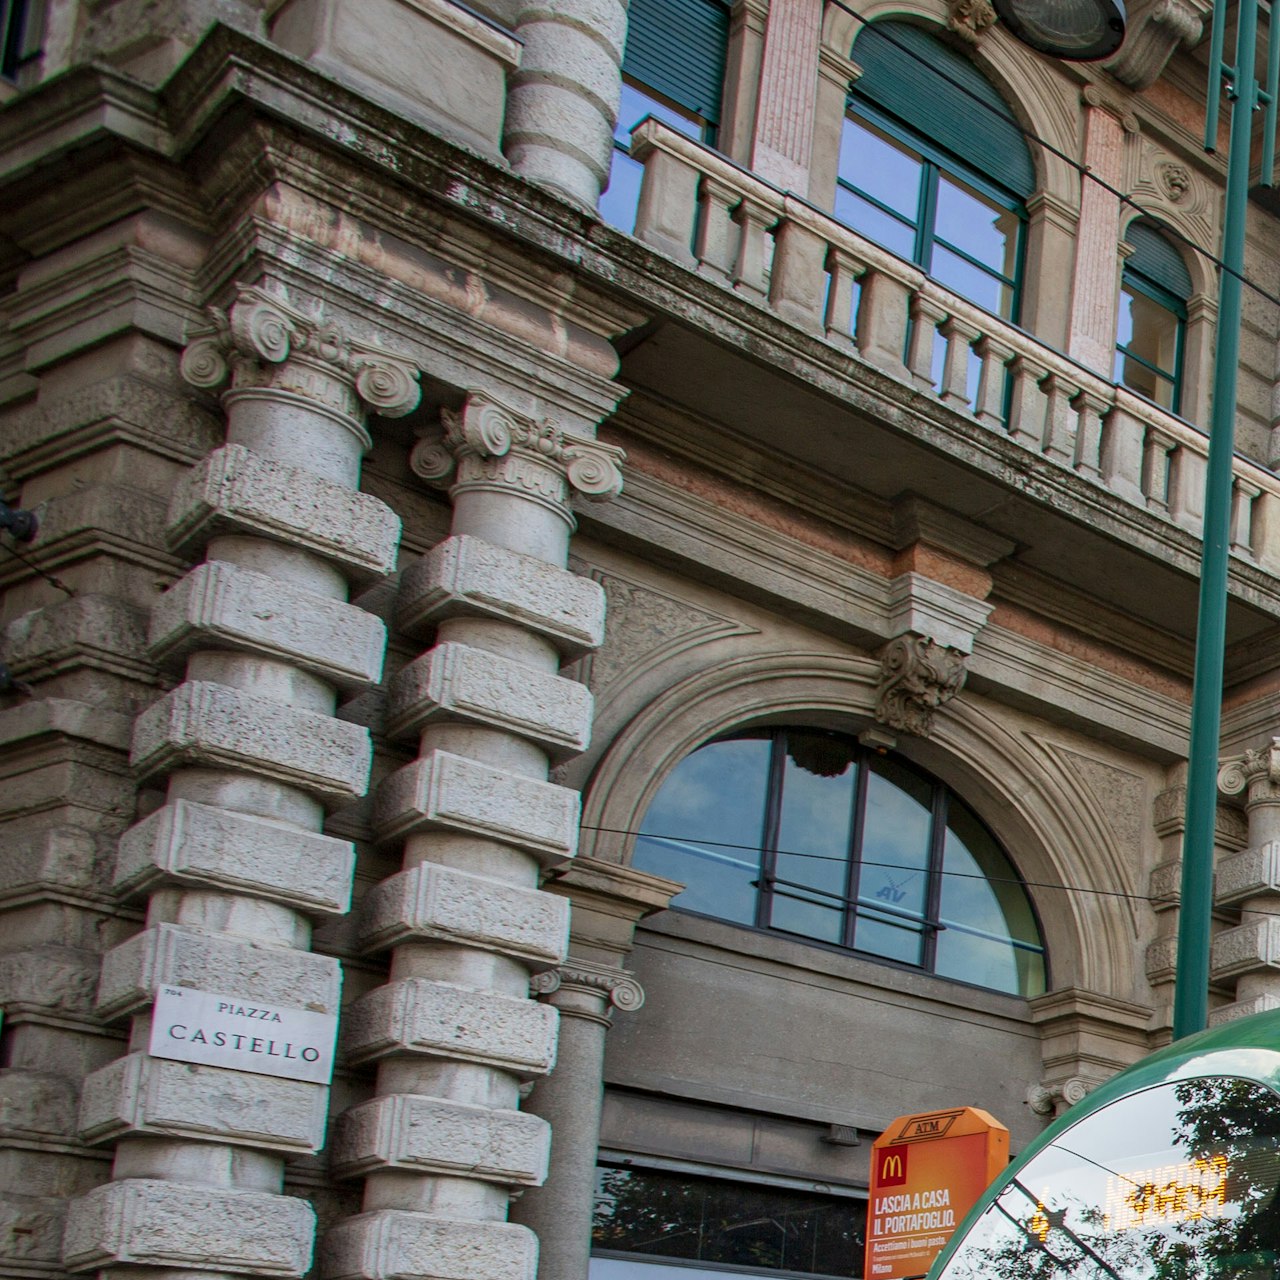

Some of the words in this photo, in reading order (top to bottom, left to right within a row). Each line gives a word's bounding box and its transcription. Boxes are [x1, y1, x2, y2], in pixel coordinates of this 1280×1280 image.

[164, 988, 183, 997] 704
[218, 1002, 283, 1023] PIAZZA
[169, 1024, 320, 1062] CASTELLO
[915, 1120, 939, 1134] ATM
[875, 1194, 911, 1215] LASCIA
[912, 1193, 921, 1210] A
[922, 1189, 950, 1209] CASA
[1103, 1156, 1226, 1233] NIGUARDA
[874, 1218, 884, 1235] IL
[885, 1209, 956, 1234] PORTAFOGLIO.
